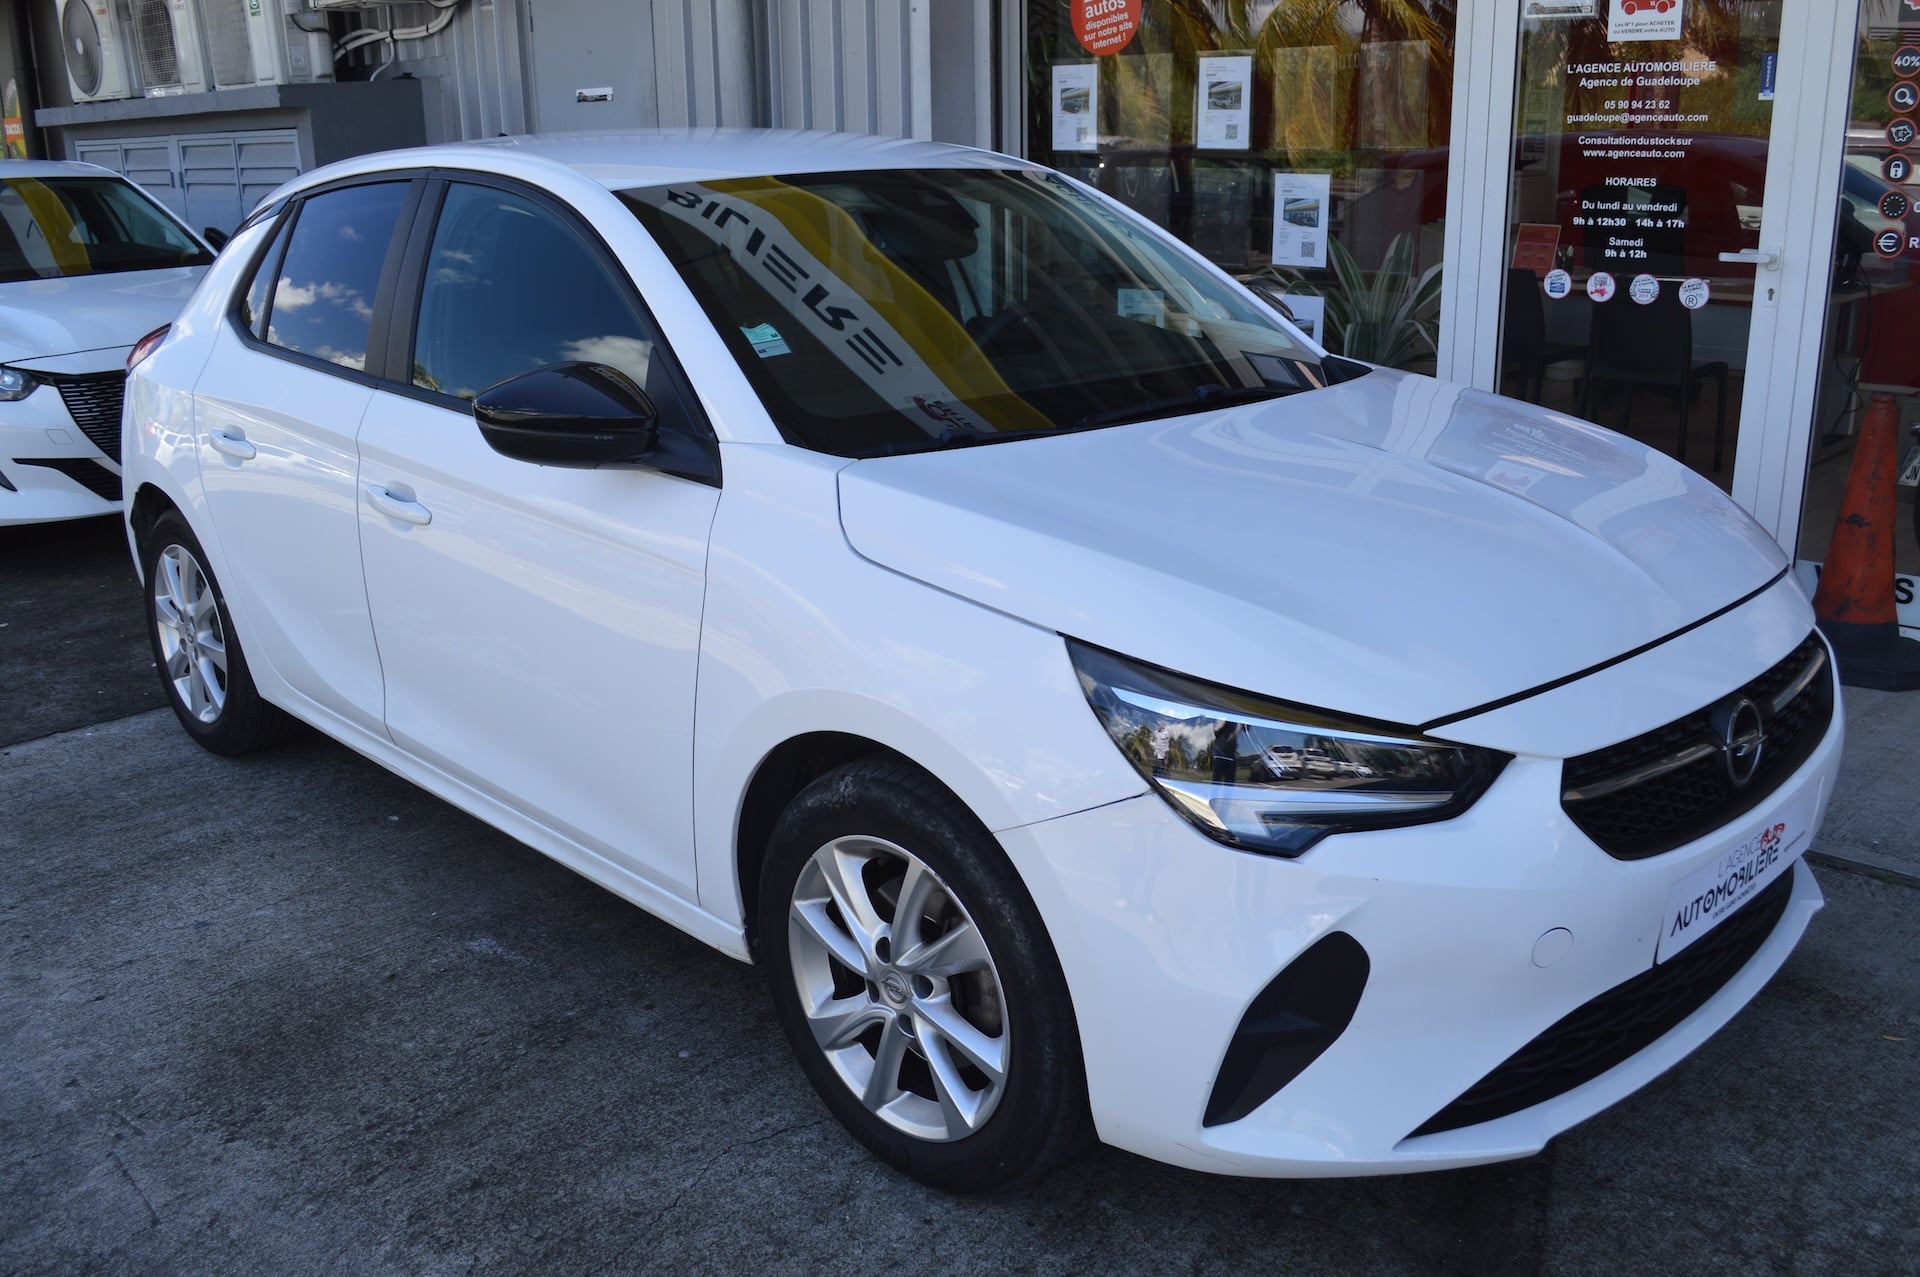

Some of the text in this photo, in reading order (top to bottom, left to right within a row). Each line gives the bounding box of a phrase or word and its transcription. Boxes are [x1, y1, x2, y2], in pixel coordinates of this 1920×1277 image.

[1085, 0, 1126, 19] autos
[1085, 12, 1129, 31] disponibles
[1084, 21, 1133, 42] sur notre site
[1093, 34, 1121, 49] internet
[1567, 60, 1716, 74] L'AGENCE AUTOMOBILIERE
[1894, 55, 1920, 67] 40%
[1579, 75, 1700, 89] Agence de Guadeloupe
[1604, 100, 1670, 109] 05 90 94 23 62
[1567, 112, 1709, 124] guadeloupe@agenceauto.com
[1578, 135, 1637, 146] Consultation
[1583, 149, 1685, 159] www.agenceauto.com
[1605, 176, 1657, 187] HORAIRES
[1582, 200, 1678, 212] Du lundi au vendredi
[1573, 216, 1685, 229] 9h à 12h30 14h à 17h
[1609, 236, 1644, 247] Samedi
[1605, 248, 1648, 258] 9h à 12h
